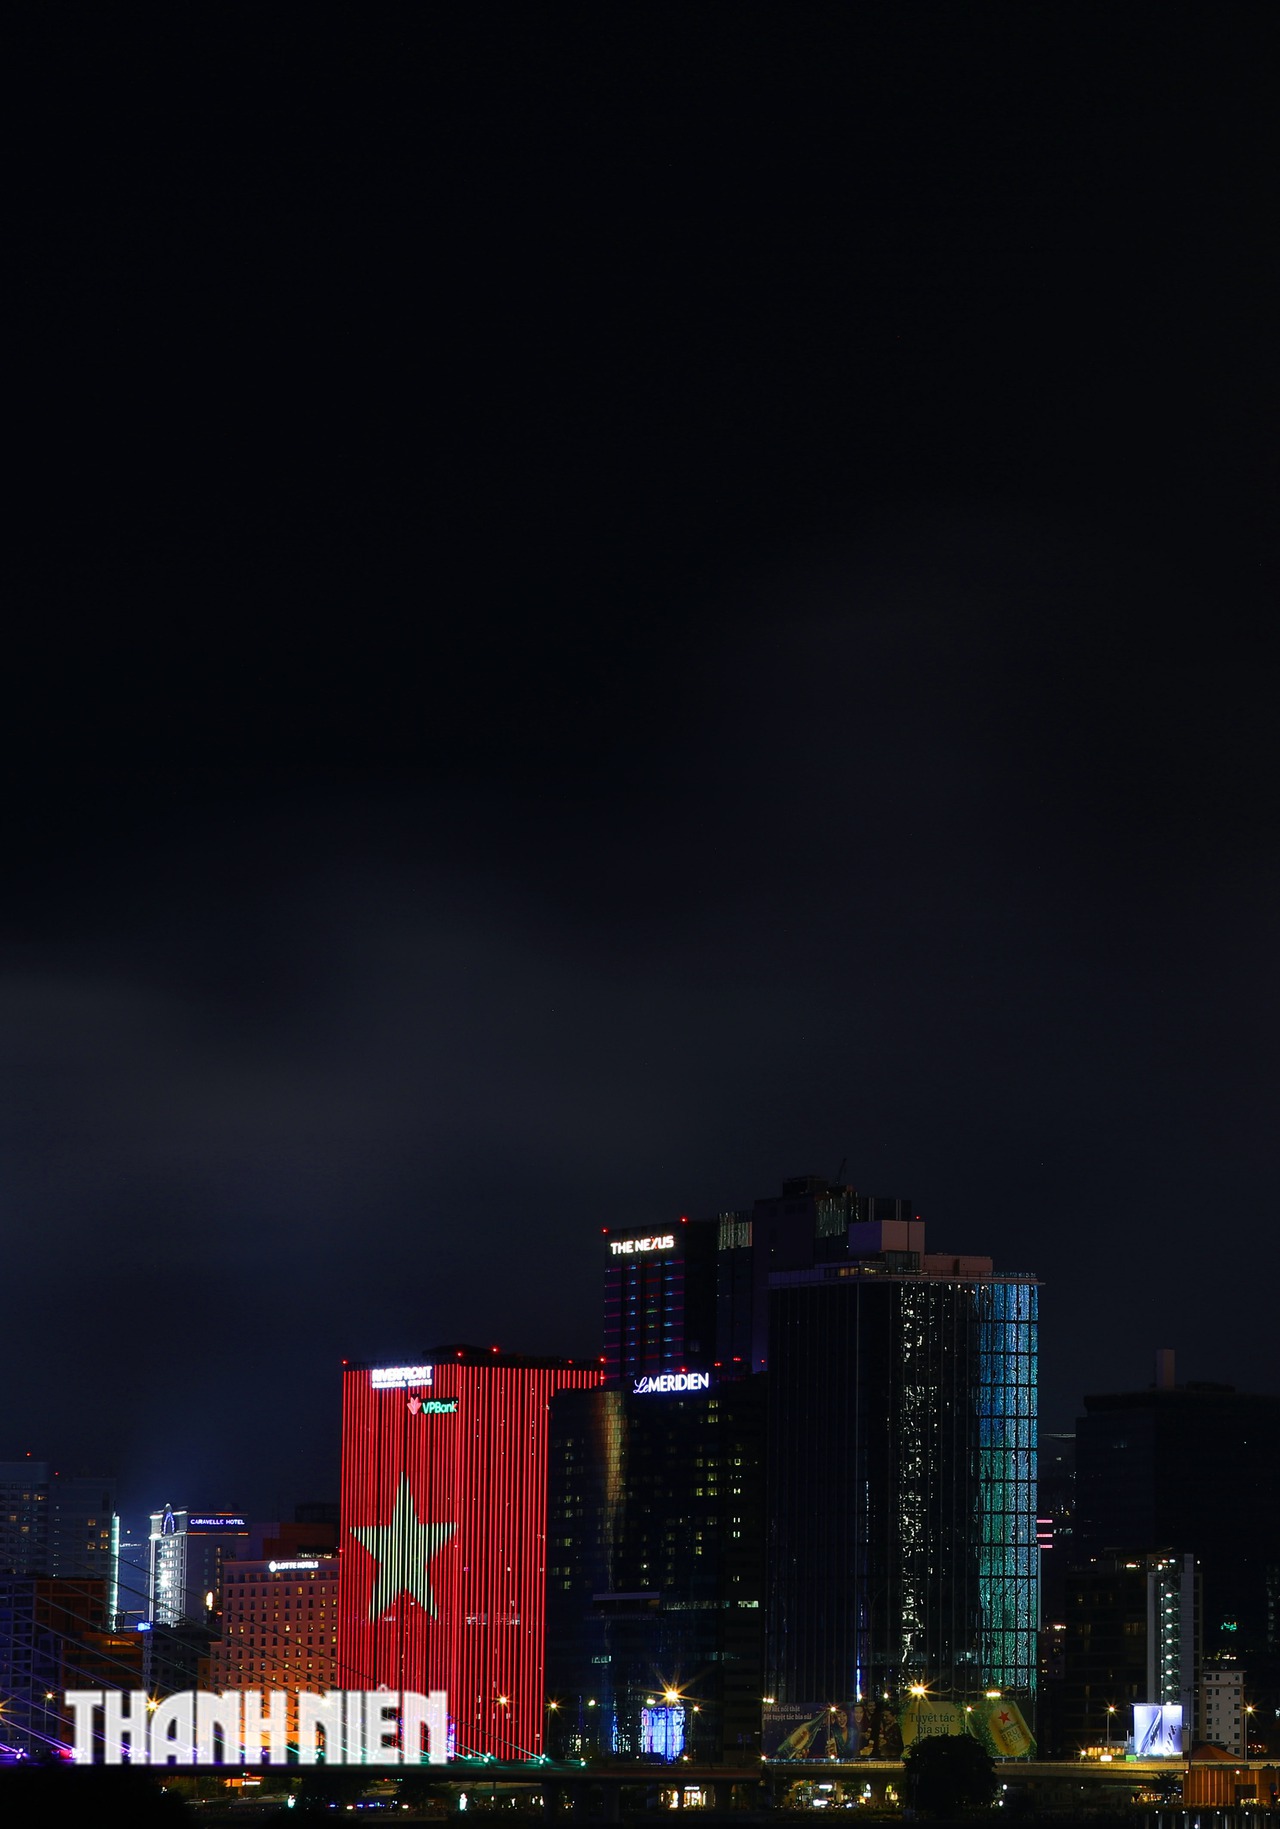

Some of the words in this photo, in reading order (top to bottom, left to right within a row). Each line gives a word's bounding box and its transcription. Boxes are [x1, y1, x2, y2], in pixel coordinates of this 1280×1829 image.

[610, 1240, 634, 1255] THE
[635, 1235, 675, 1252] NEXUS
[422, 1401, 459, 1414] VPBank
[277, 1562, 297, 1570] LOTTE
[940, 1712, 956, 1723] tác
